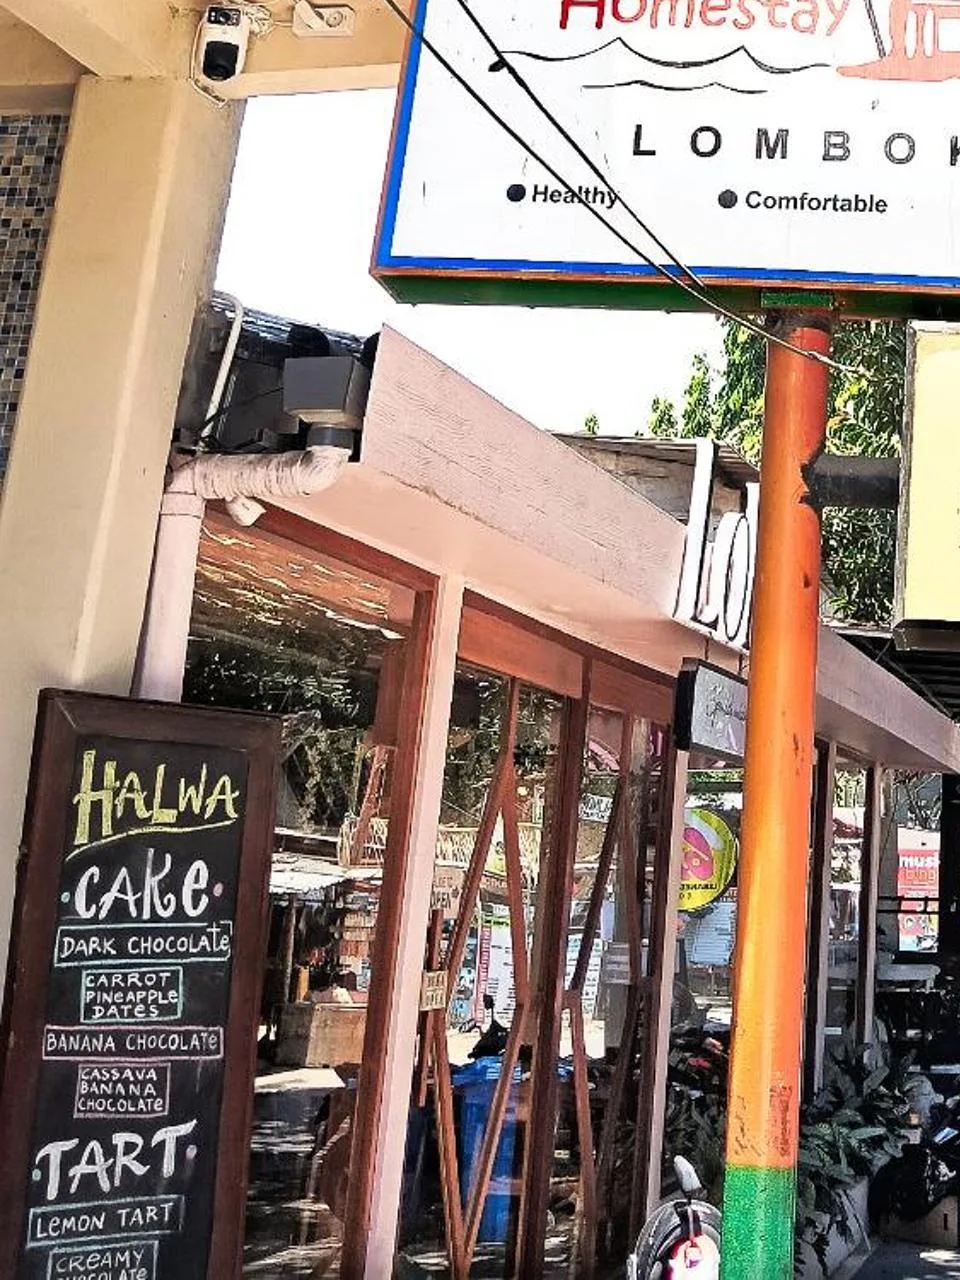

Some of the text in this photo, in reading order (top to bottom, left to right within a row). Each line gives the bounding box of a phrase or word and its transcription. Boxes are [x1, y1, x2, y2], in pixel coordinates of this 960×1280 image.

[531, 183, 620, 210] Healthy
[744, 190, 889, 216] Comfortable
[72, 749, 240, 845] HALWA
[60, 936, 117, 959] DARK
[86, 972, 171, 988] CARROT
[47, 1033, 117, 1052] BANANA
[80, 1067, 158, 1081] CASSAVA
[79, 1081, 157, 1096] BANANA
[35, 1119, 198, 1201] TART
[117, 1201, 175, 1228] TART
